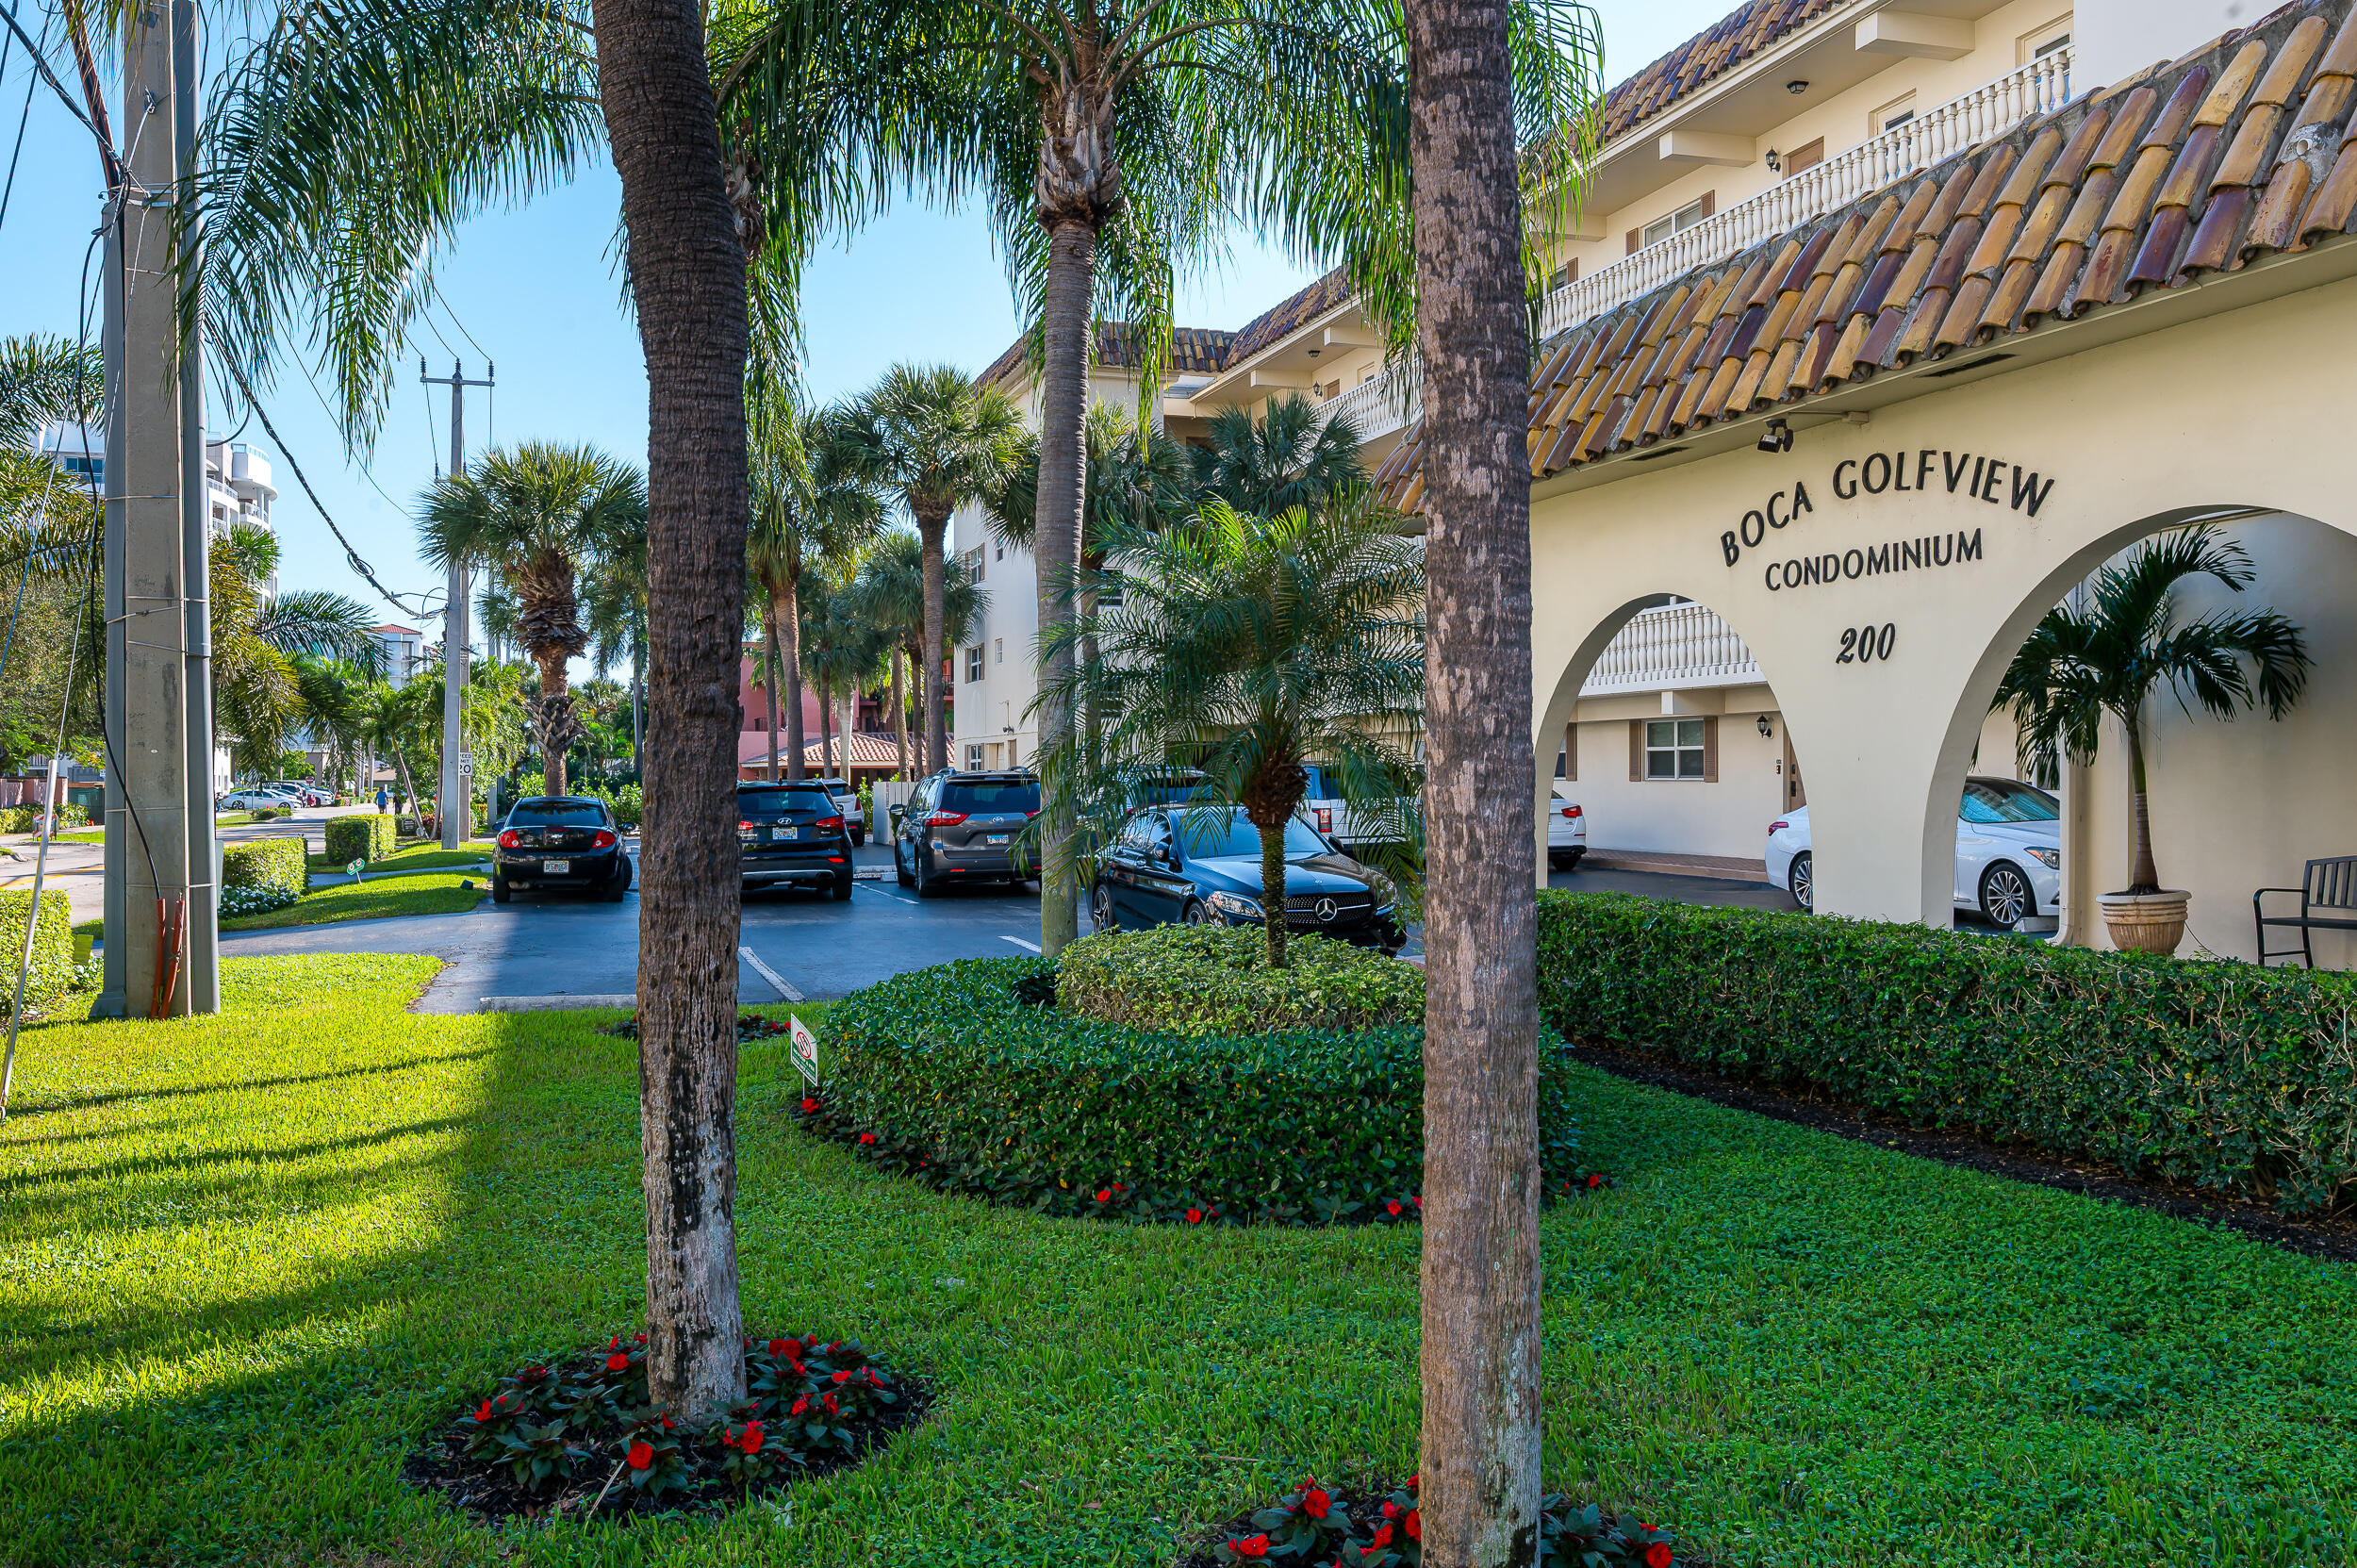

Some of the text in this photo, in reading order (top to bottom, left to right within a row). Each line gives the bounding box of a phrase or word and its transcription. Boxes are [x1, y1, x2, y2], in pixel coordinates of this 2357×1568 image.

[1721, 450, 2054, 567] BOCA GOLFVIEW
[1765, 527, 1983, 591] CONDOMINIUM
[1836, 622, 1896, 665] 200
